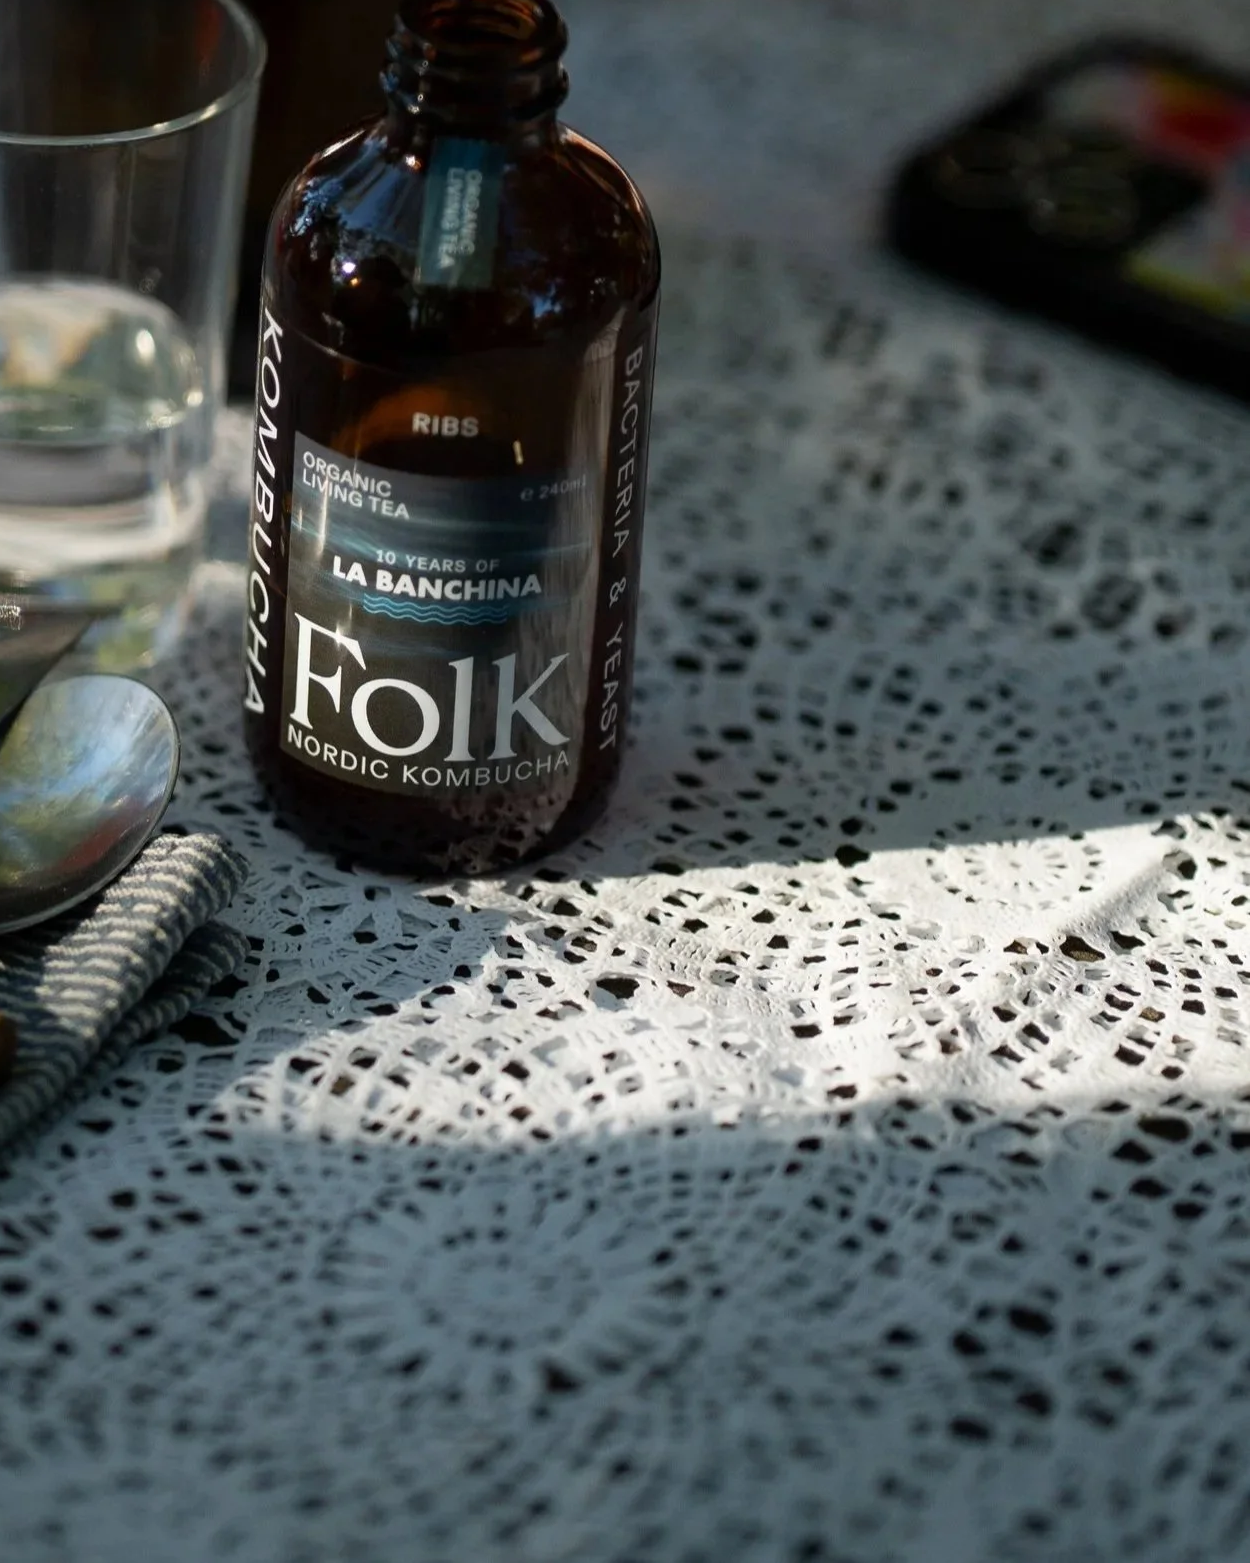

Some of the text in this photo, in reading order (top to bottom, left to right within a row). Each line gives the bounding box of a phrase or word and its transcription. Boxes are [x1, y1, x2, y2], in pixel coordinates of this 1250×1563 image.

[411, 411, 479, 437] RIBS
[302, 450, 393, 498] ORGANIC
[302, 468, 410, 520] LIVING TEA
[245, 306, 284, 714] KOMBUCHA
[376, 549, 501, 574] 10 YEARS OF
[597, 345, 644, 751] BACTERIA & YEAST
[332, 555, 542, 601] LA BANCHINA
[289, 611, 571, 763] Folk
[286, 725, 570, 788] NORDIC KOMBUCHA
